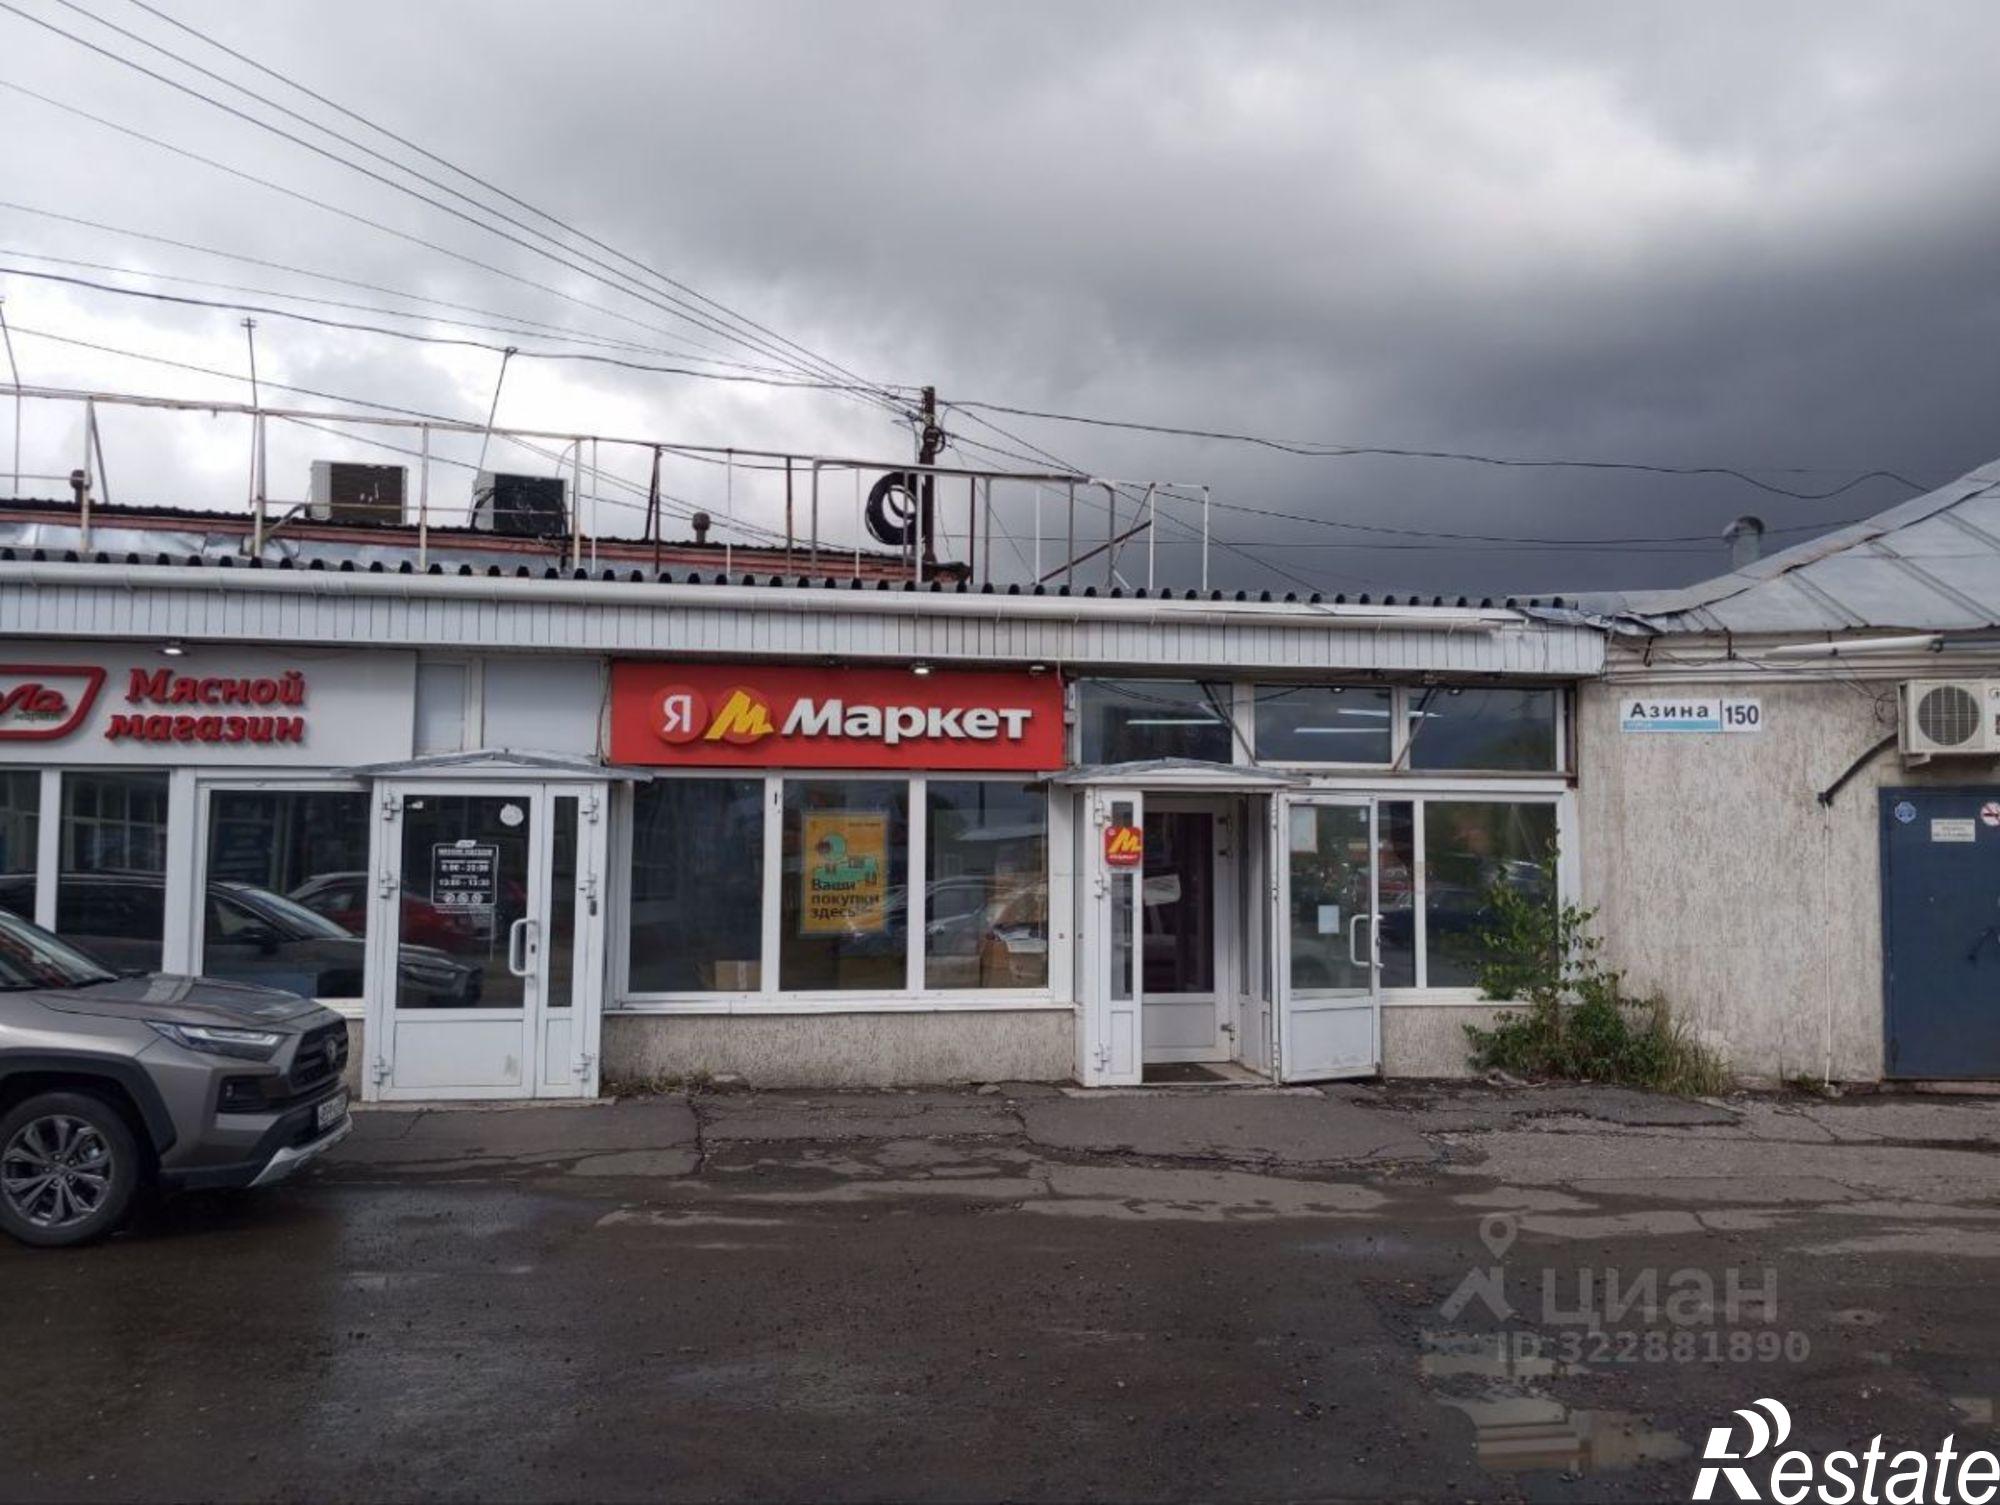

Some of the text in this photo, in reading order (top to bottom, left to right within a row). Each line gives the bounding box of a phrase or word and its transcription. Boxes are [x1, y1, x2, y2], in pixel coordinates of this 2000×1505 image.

[125, 668, 305, 705] Мясной
[663, 694, 692, 733] Я
[781, 698, 1032, 744] Маркет
[1630, 702, 1760, 725] Азина 150
[105, 714, 304, 742] магазин
[812, 878, 856, 891] Ваши
[811, 894, 880, 907] покупки
[811, 907, 856, 920] здесь
